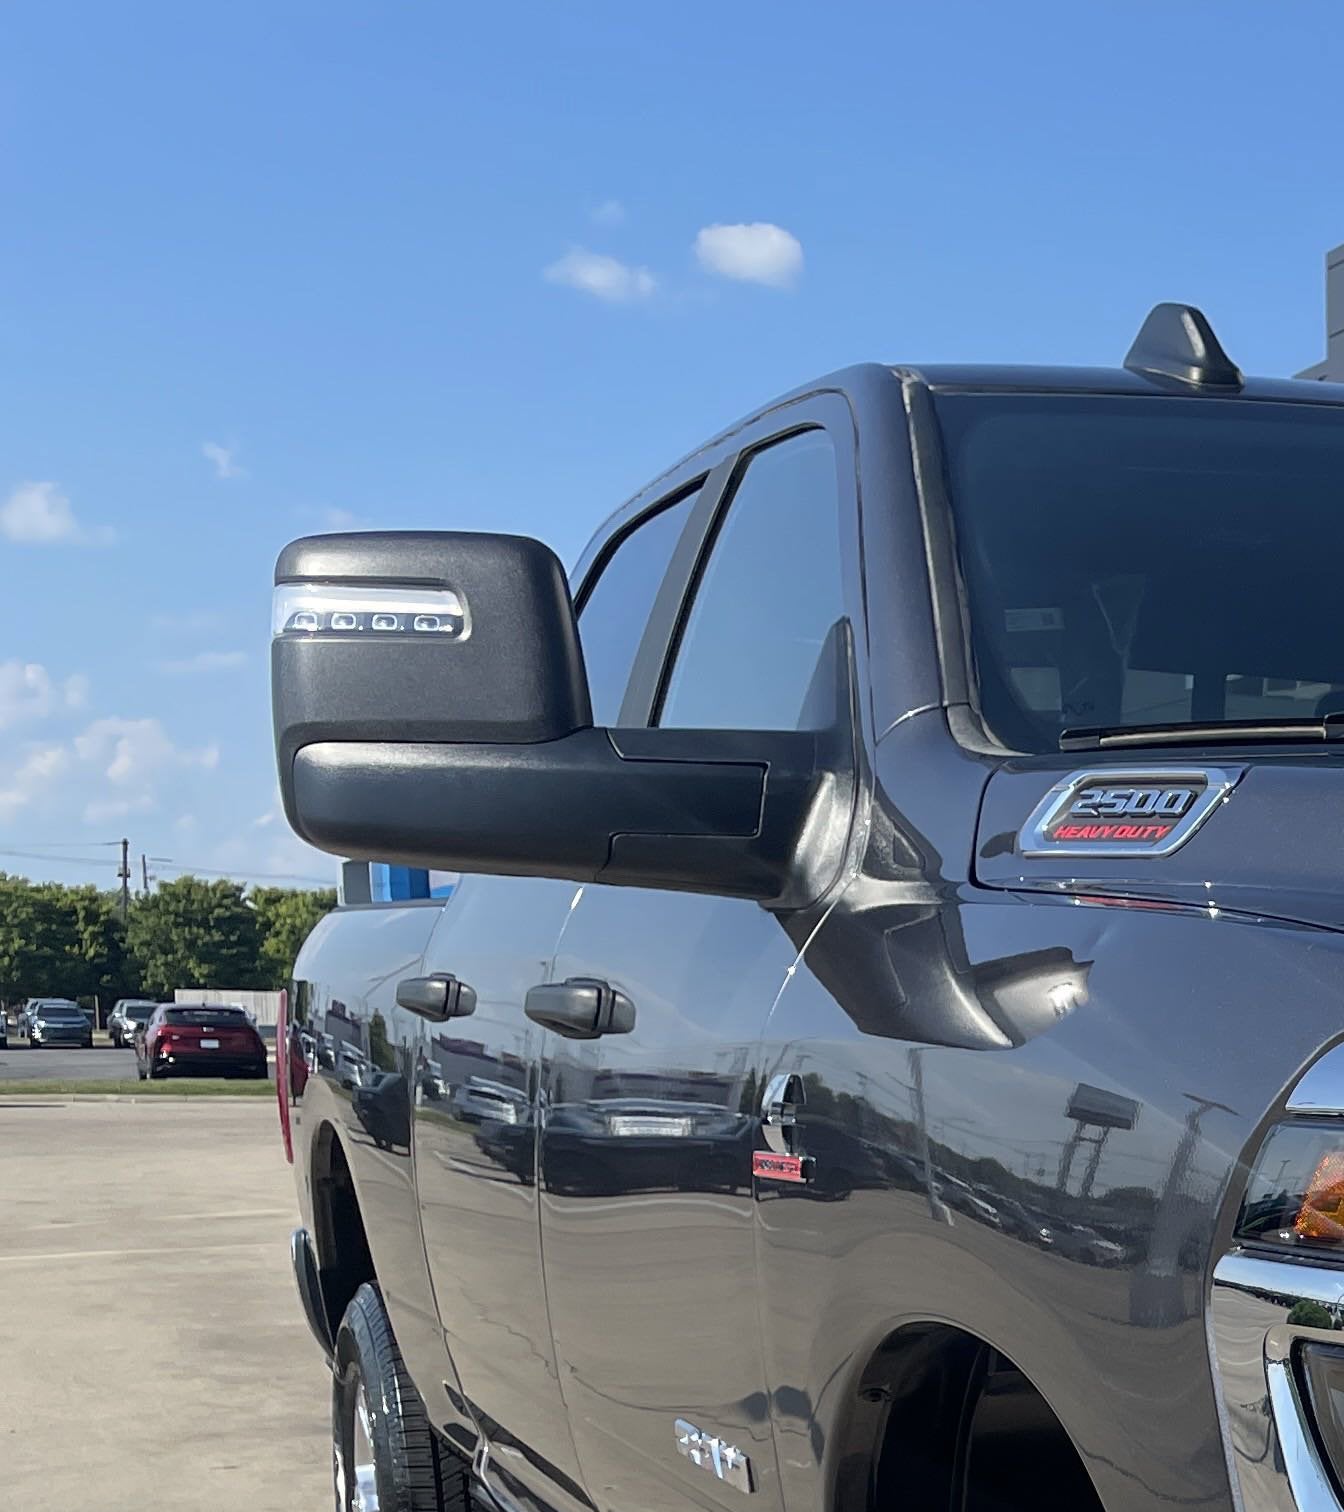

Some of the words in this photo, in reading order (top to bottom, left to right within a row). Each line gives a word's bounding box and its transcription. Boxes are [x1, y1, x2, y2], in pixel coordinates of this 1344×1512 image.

[1069, 788, 1198, 819] 2500
[1053, 826, 1116, 840] HEAVY
[1113, 825, 1170, 839] DUTY
